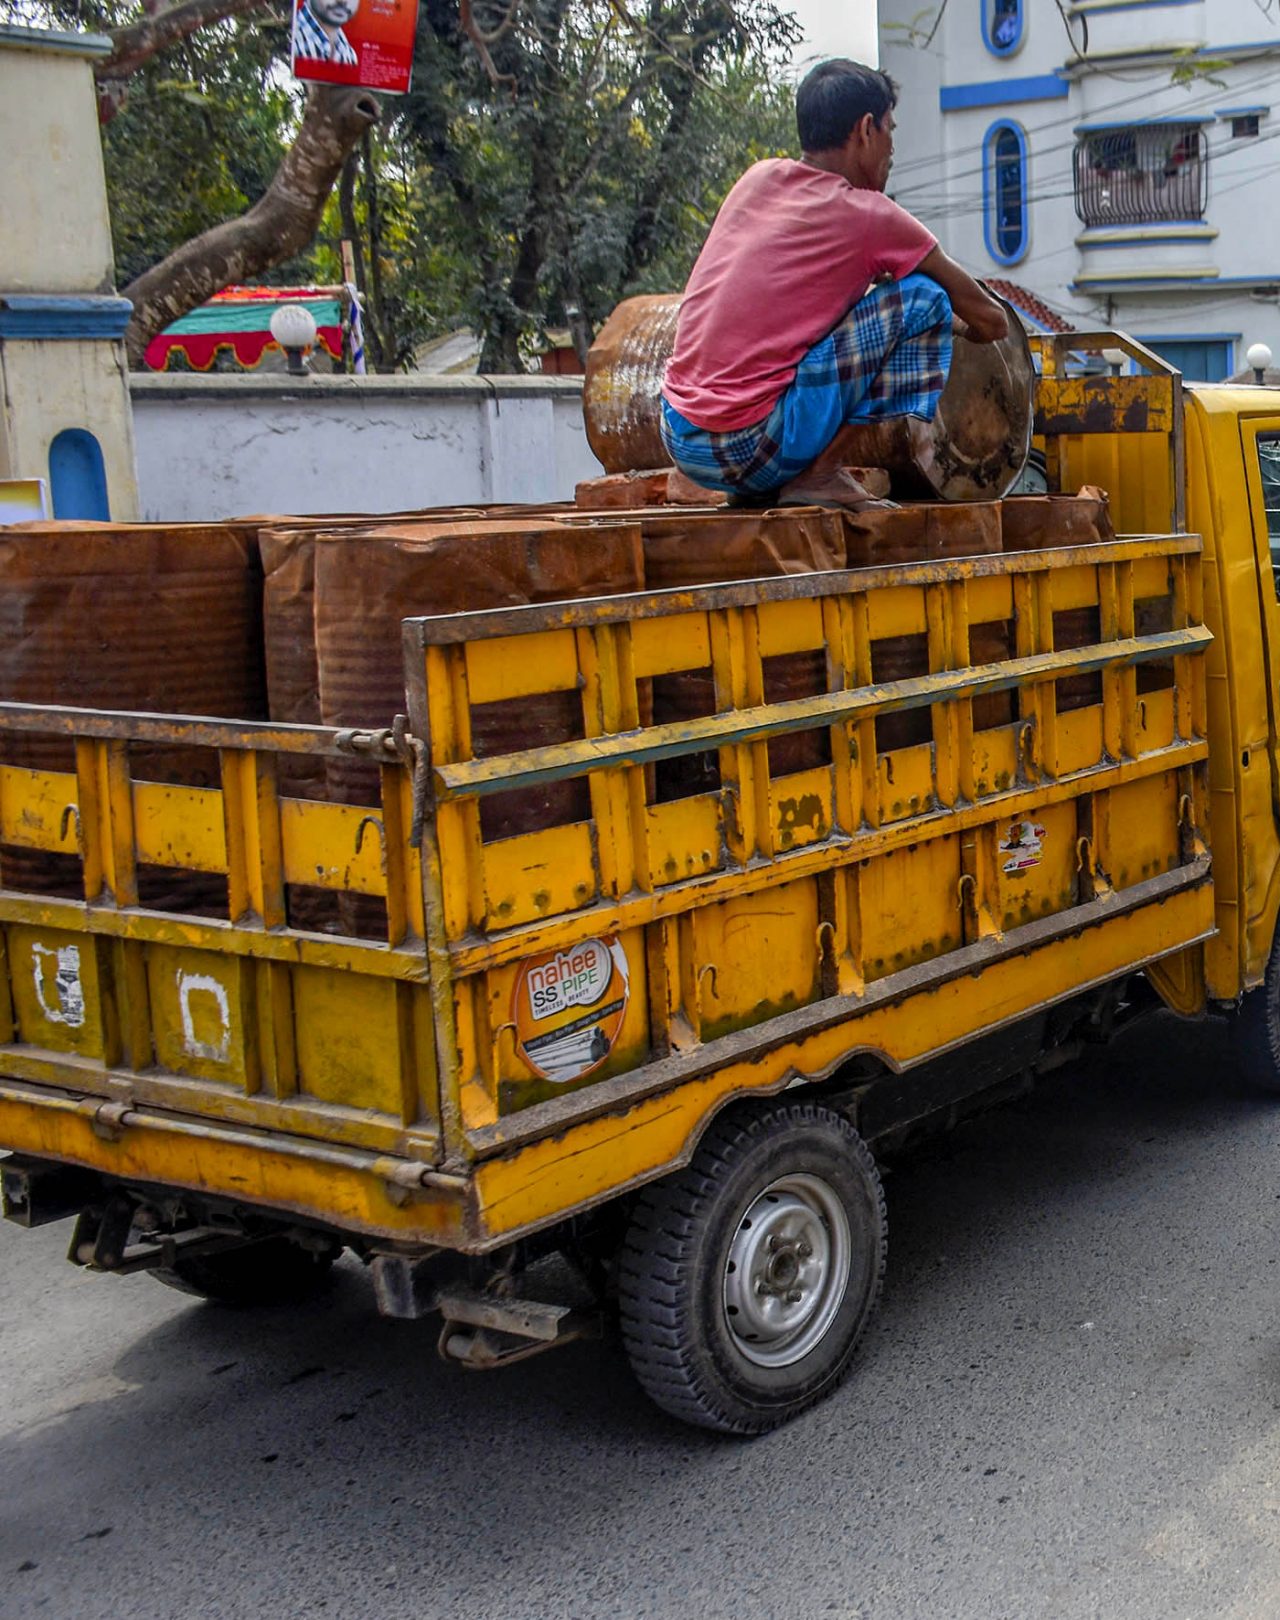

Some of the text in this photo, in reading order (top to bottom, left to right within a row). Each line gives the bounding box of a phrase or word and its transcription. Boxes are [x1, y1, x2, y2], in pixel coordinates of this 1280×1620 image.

[531, 949, 596, 991] nahee
[533, 968, 599, 1007] SS PIPE
[535, 988, 589, 1015] TIMELESS BEAUTY
